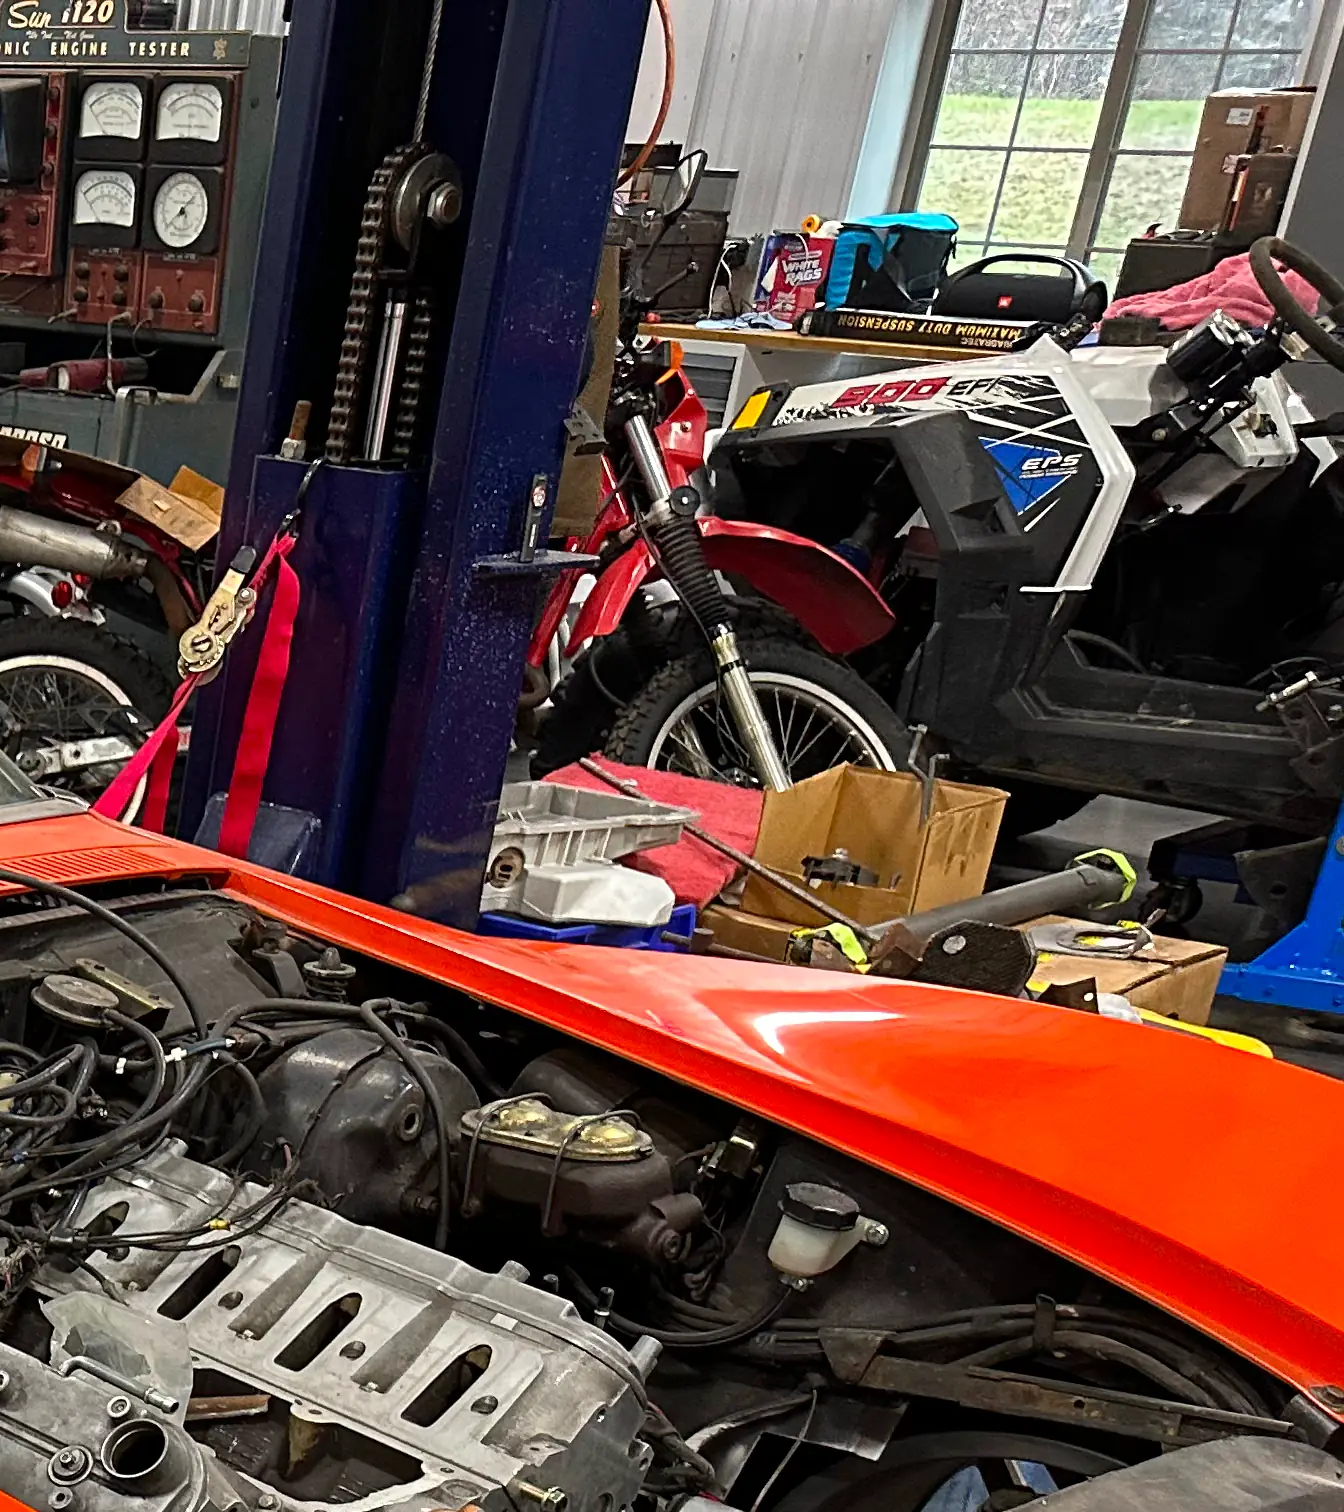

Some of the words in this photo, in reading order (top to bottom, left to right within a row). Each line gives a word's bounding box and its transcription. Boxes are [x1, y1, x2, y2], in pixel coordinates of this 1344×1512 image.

[7, 0, 52, 29] Sun
[49, 41, 108, 56] ENGINE
[128, 41, 190, 57] TESTER
[781, 258, 821, 274] WHITE
[784, 267, 823, 287] RAGS
[837, 314, 915, 331] SUSPENSION
[917, 321, 953, 334] DUTY
[955, 324, 1022, 341] MAXIMUM
[1021, 452, 1084, 470] EPS
